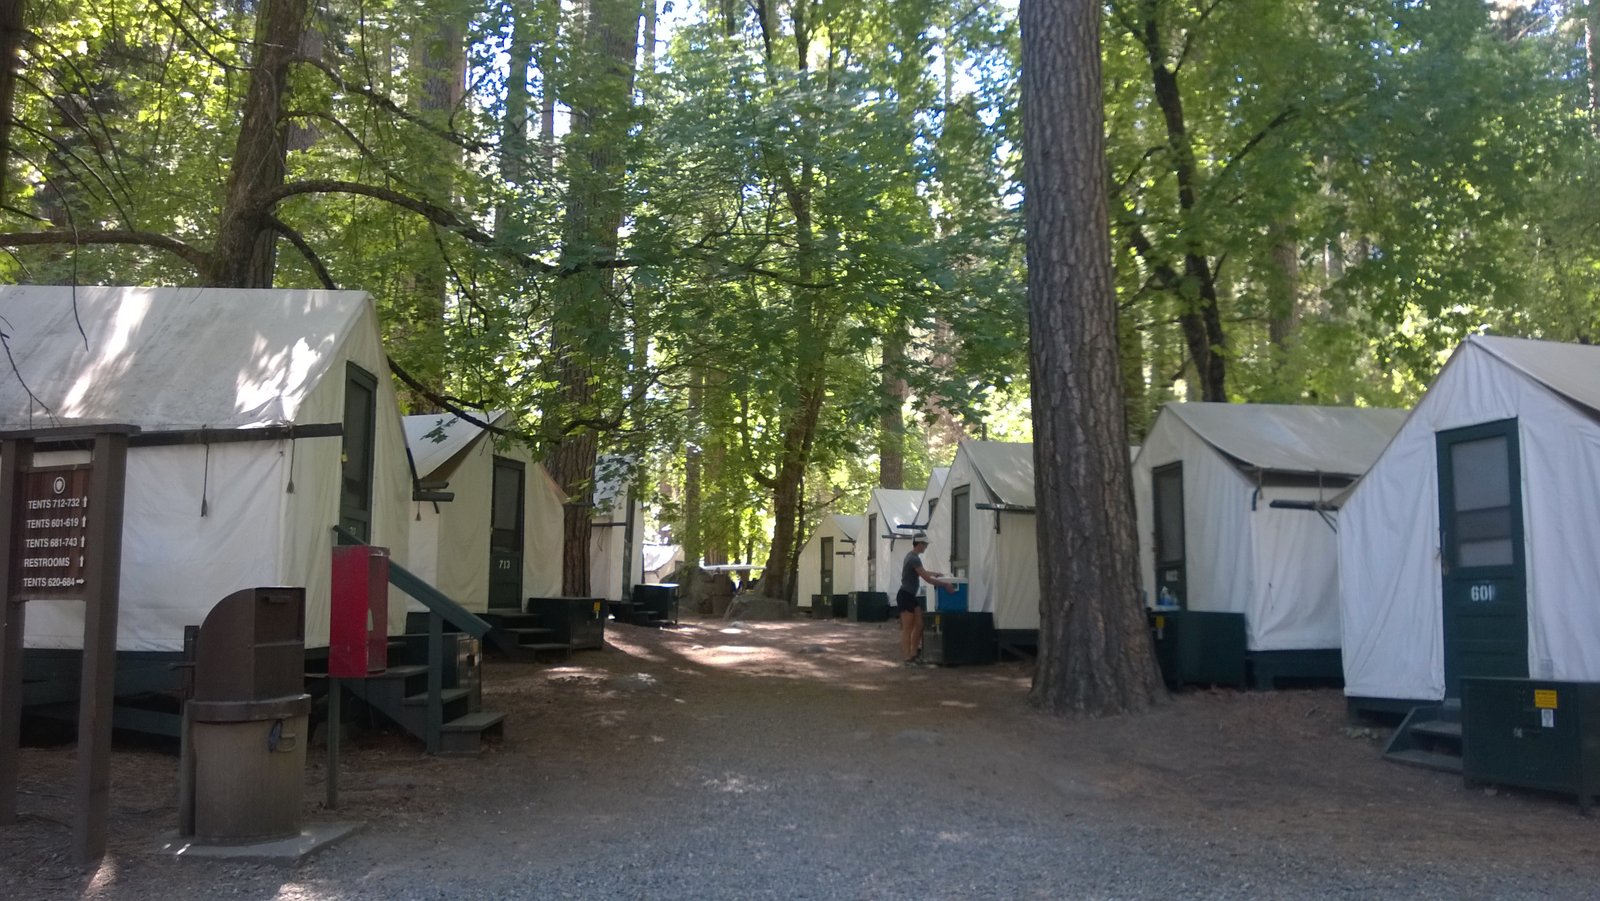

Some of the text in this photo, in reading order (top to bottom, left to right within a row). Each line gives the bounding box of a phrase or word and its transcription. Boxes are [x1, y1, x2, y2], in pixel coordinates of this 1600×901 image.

[28, 498, 79, 509] TENTS 712-732
[27, 518, 79, 529] TENTS 601-619
[26, 538, 77, 548] TENTS 681-743
[24, 557, 70, 567] RESTROOMS
[499, 560, 510, 569] 713
[24, 577, 75, 587] TENTS 620-684
[1471, 584, 1493, 602] 601
